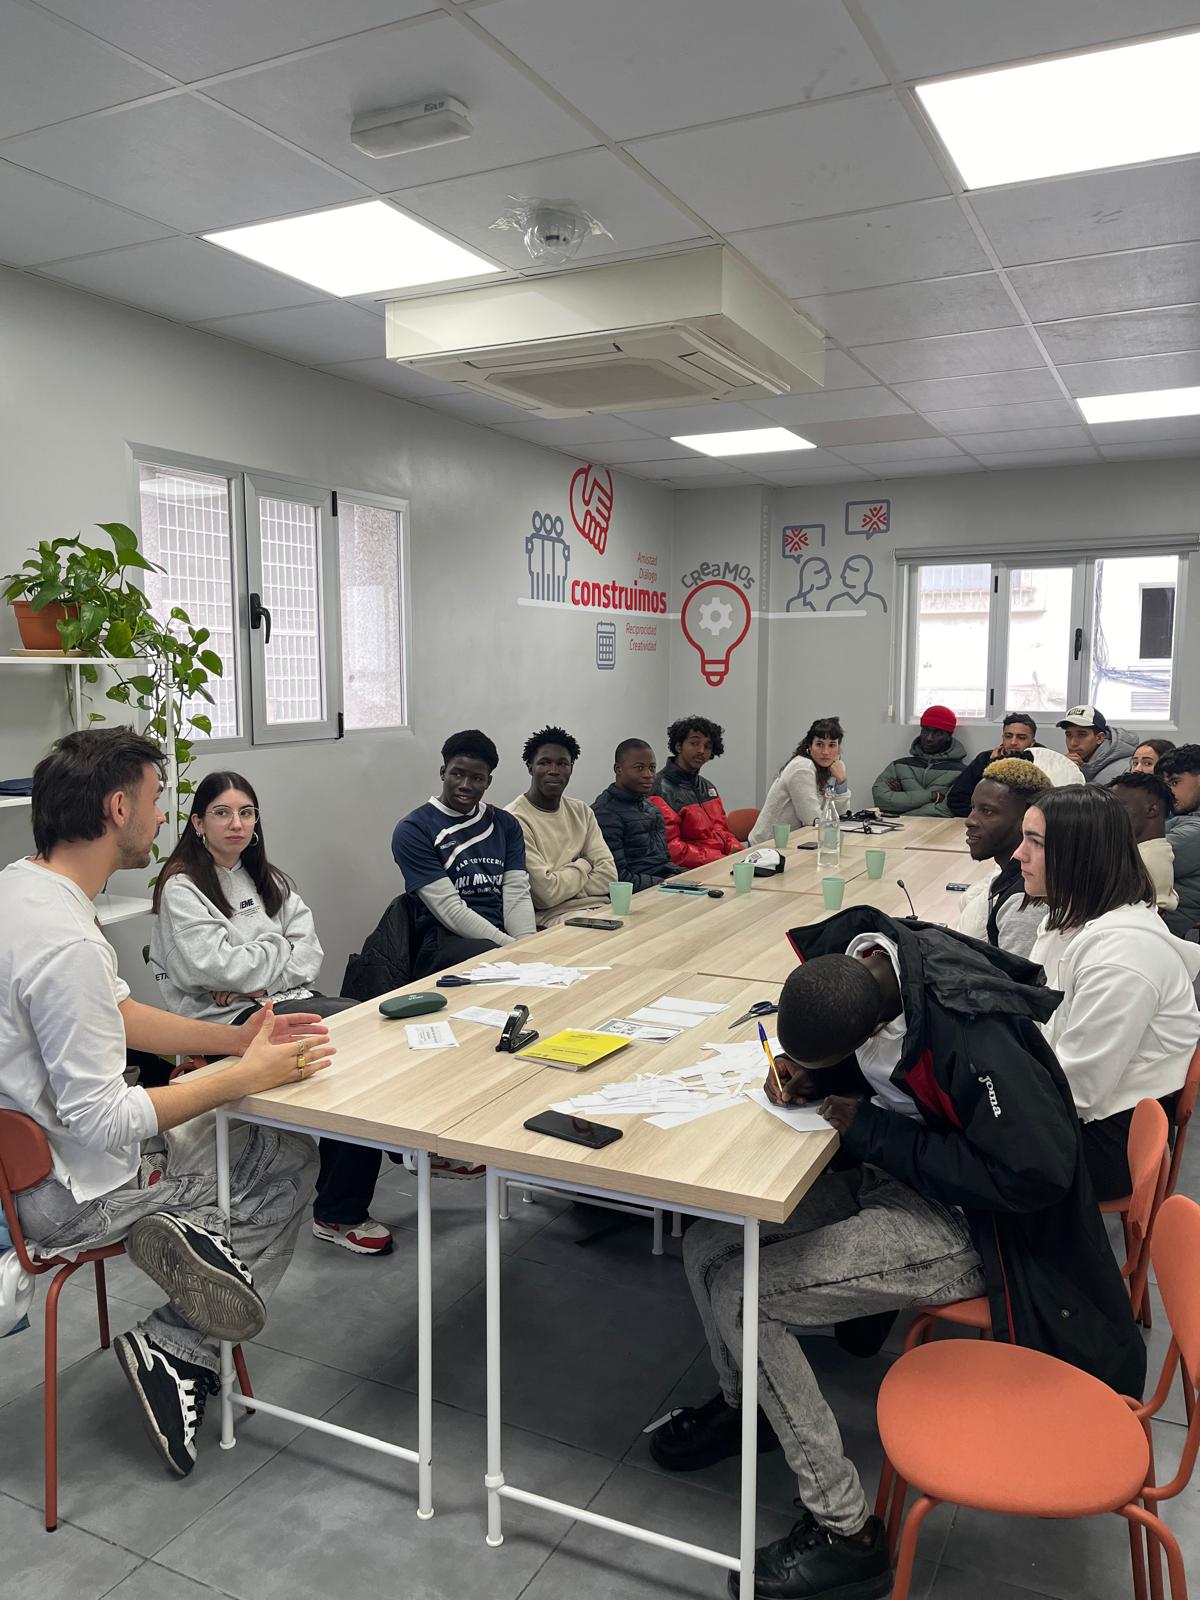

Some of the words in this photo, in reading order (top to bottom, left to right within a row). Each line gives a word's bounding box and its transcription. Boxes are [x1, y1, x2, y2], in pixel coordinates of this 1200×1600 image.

[638, 552, 657, 566] Amistad
[571, 579, 667, 614] construimos
[626, 622, 657, 637] Reciprocidad
[629, 639, 657, 652] Creatividad
